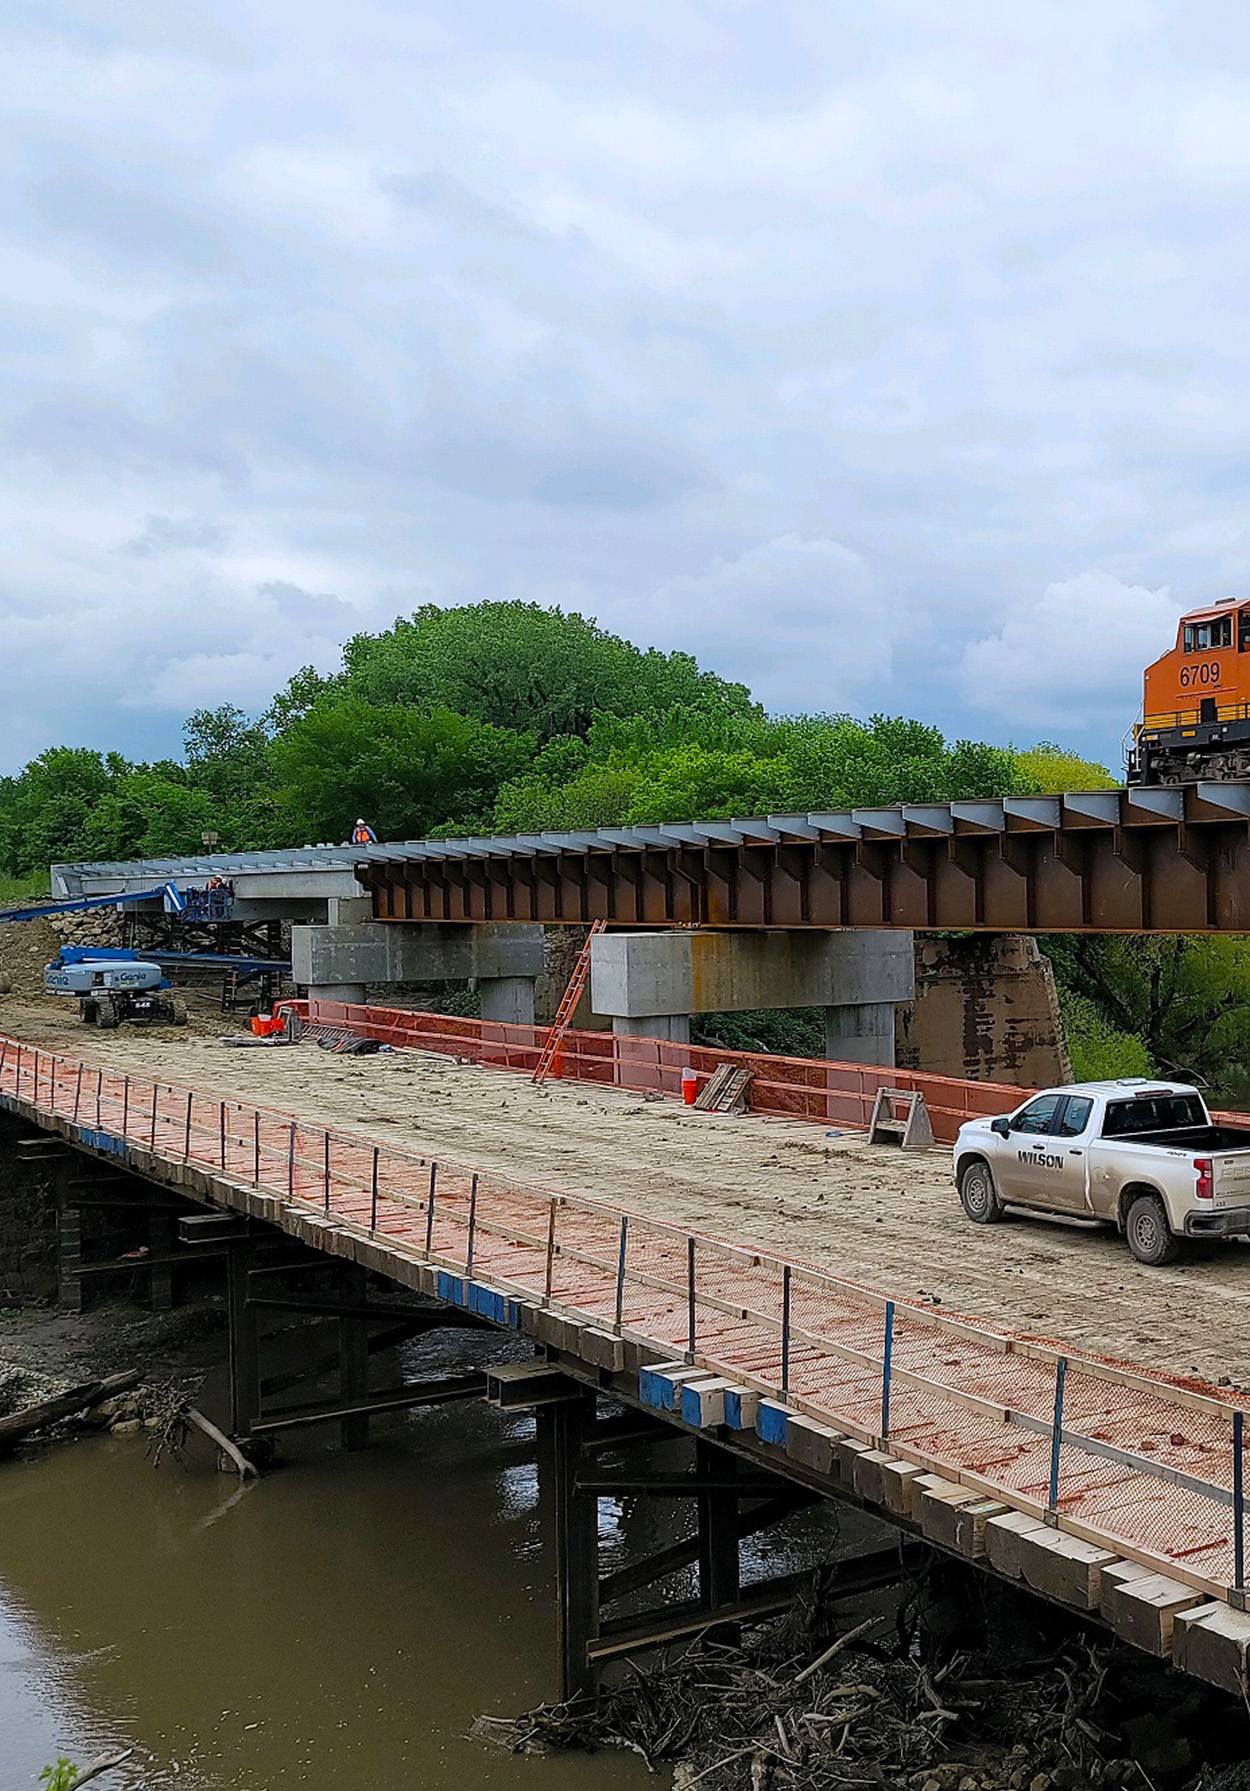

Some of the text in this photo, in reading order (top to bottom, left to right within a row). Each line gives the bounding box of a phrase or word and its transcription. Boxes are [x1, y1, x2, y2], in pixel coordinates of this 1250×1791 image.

[1180, 662, 1220, 687] 6709
[120, 972, 147, 981] Genie
[1017, 1150, 1065, 1169] WILSON
